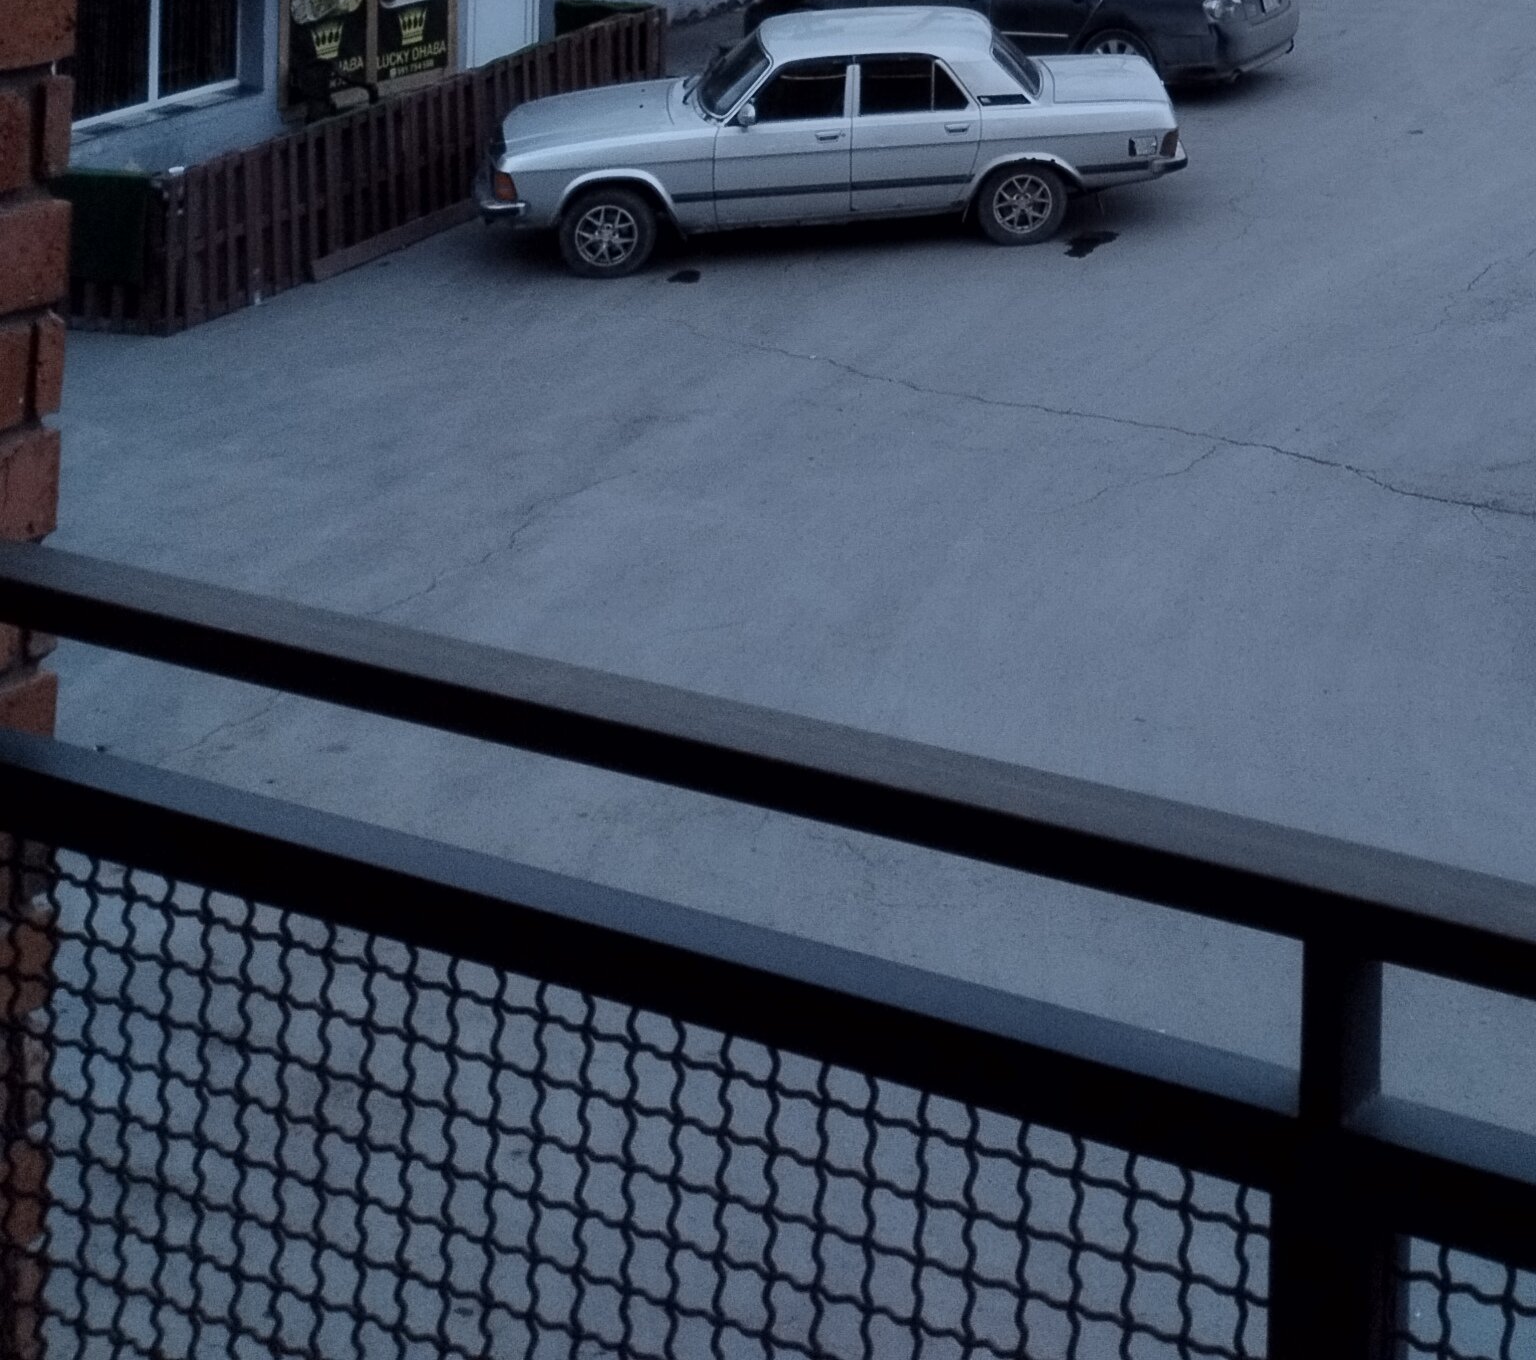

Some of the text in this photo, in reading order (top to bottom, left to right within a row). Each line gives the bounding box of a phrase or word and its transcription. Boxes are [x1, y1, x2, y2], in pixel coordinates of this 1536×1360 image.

[338, 55, 365, 72] ABA
[376, 40, 447, 70] LUCKY DHABA
